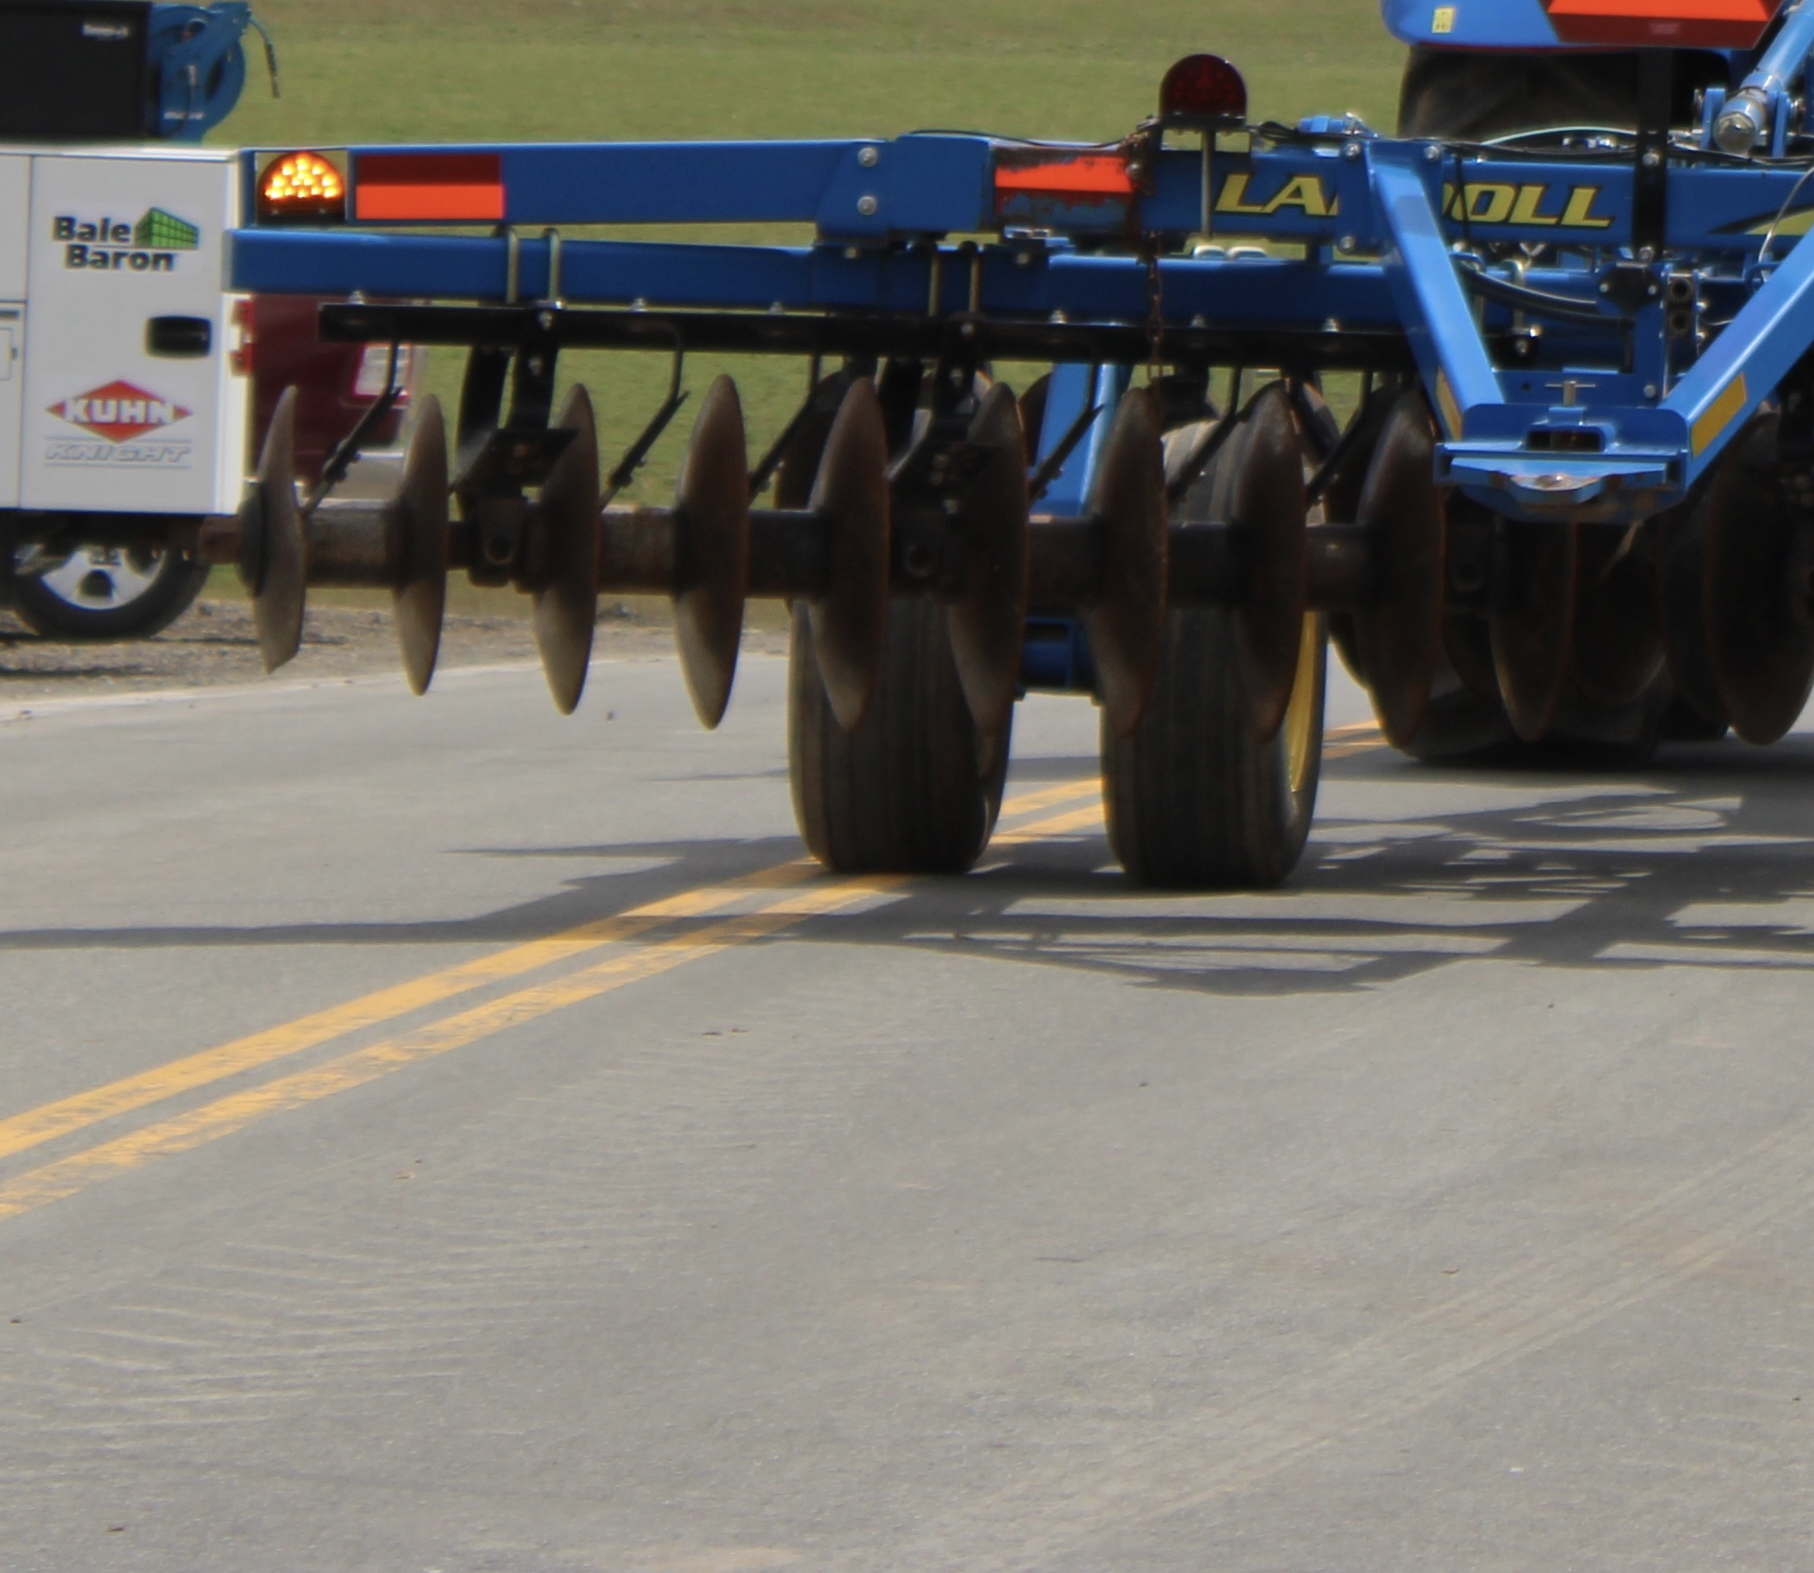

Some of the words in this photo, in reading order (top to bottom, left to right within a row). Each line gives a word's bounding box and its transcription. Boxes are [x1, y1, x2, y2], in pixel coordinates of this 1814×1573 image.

[1215, 173, 1615, 228] LAOLL
[53, 215, 132, 243] Bale
[65, 243, 176, 271] Baron
[64, 399, 175, 424] KUHN
[45, 444, 191, 462] KNIGHT
